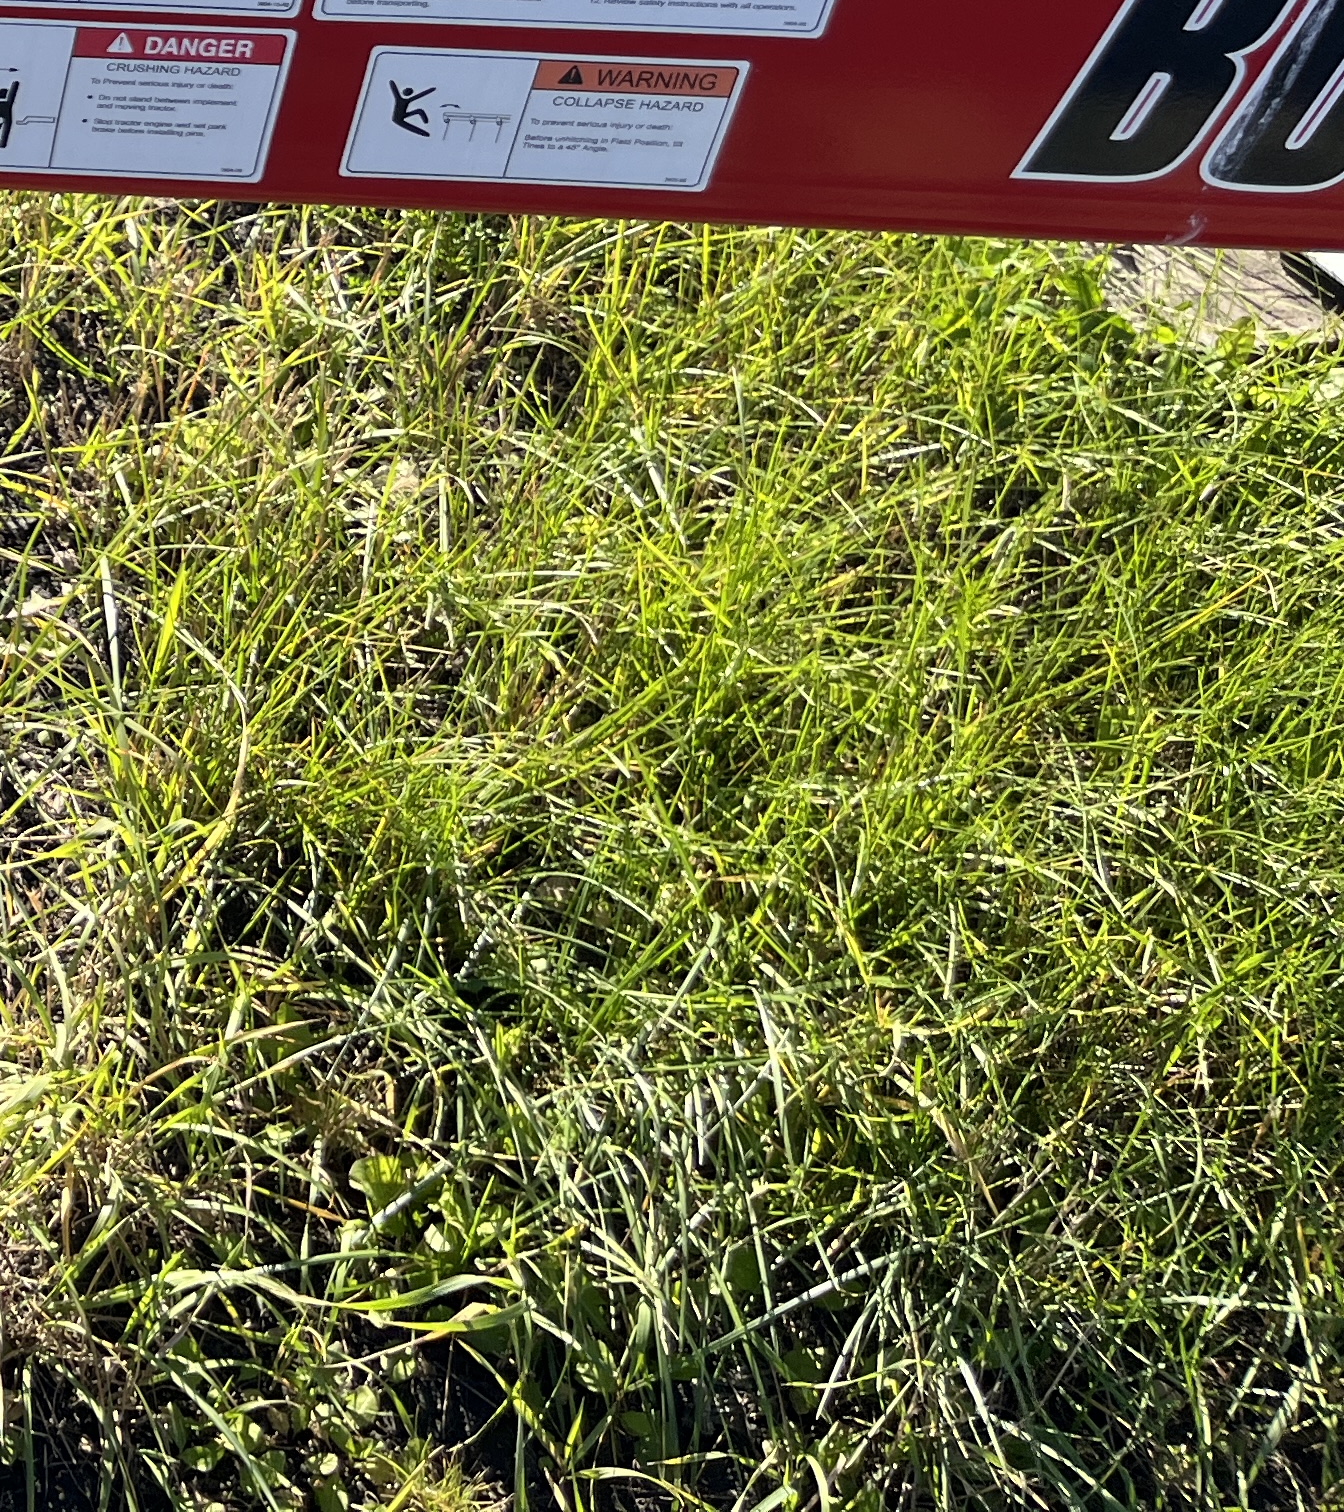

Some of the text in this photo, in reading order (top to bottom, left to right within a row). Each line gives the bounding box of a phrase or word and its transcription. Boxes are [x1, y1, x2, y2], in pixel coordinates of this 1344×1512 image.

[143, 36, 255, 58] DANGER
[106, 62, 241, 76] CRUSHING HAZARD
[596, 69, 718, 90] WARNING
[551, 96, 705, 111] COLLAPSE HAZARD
